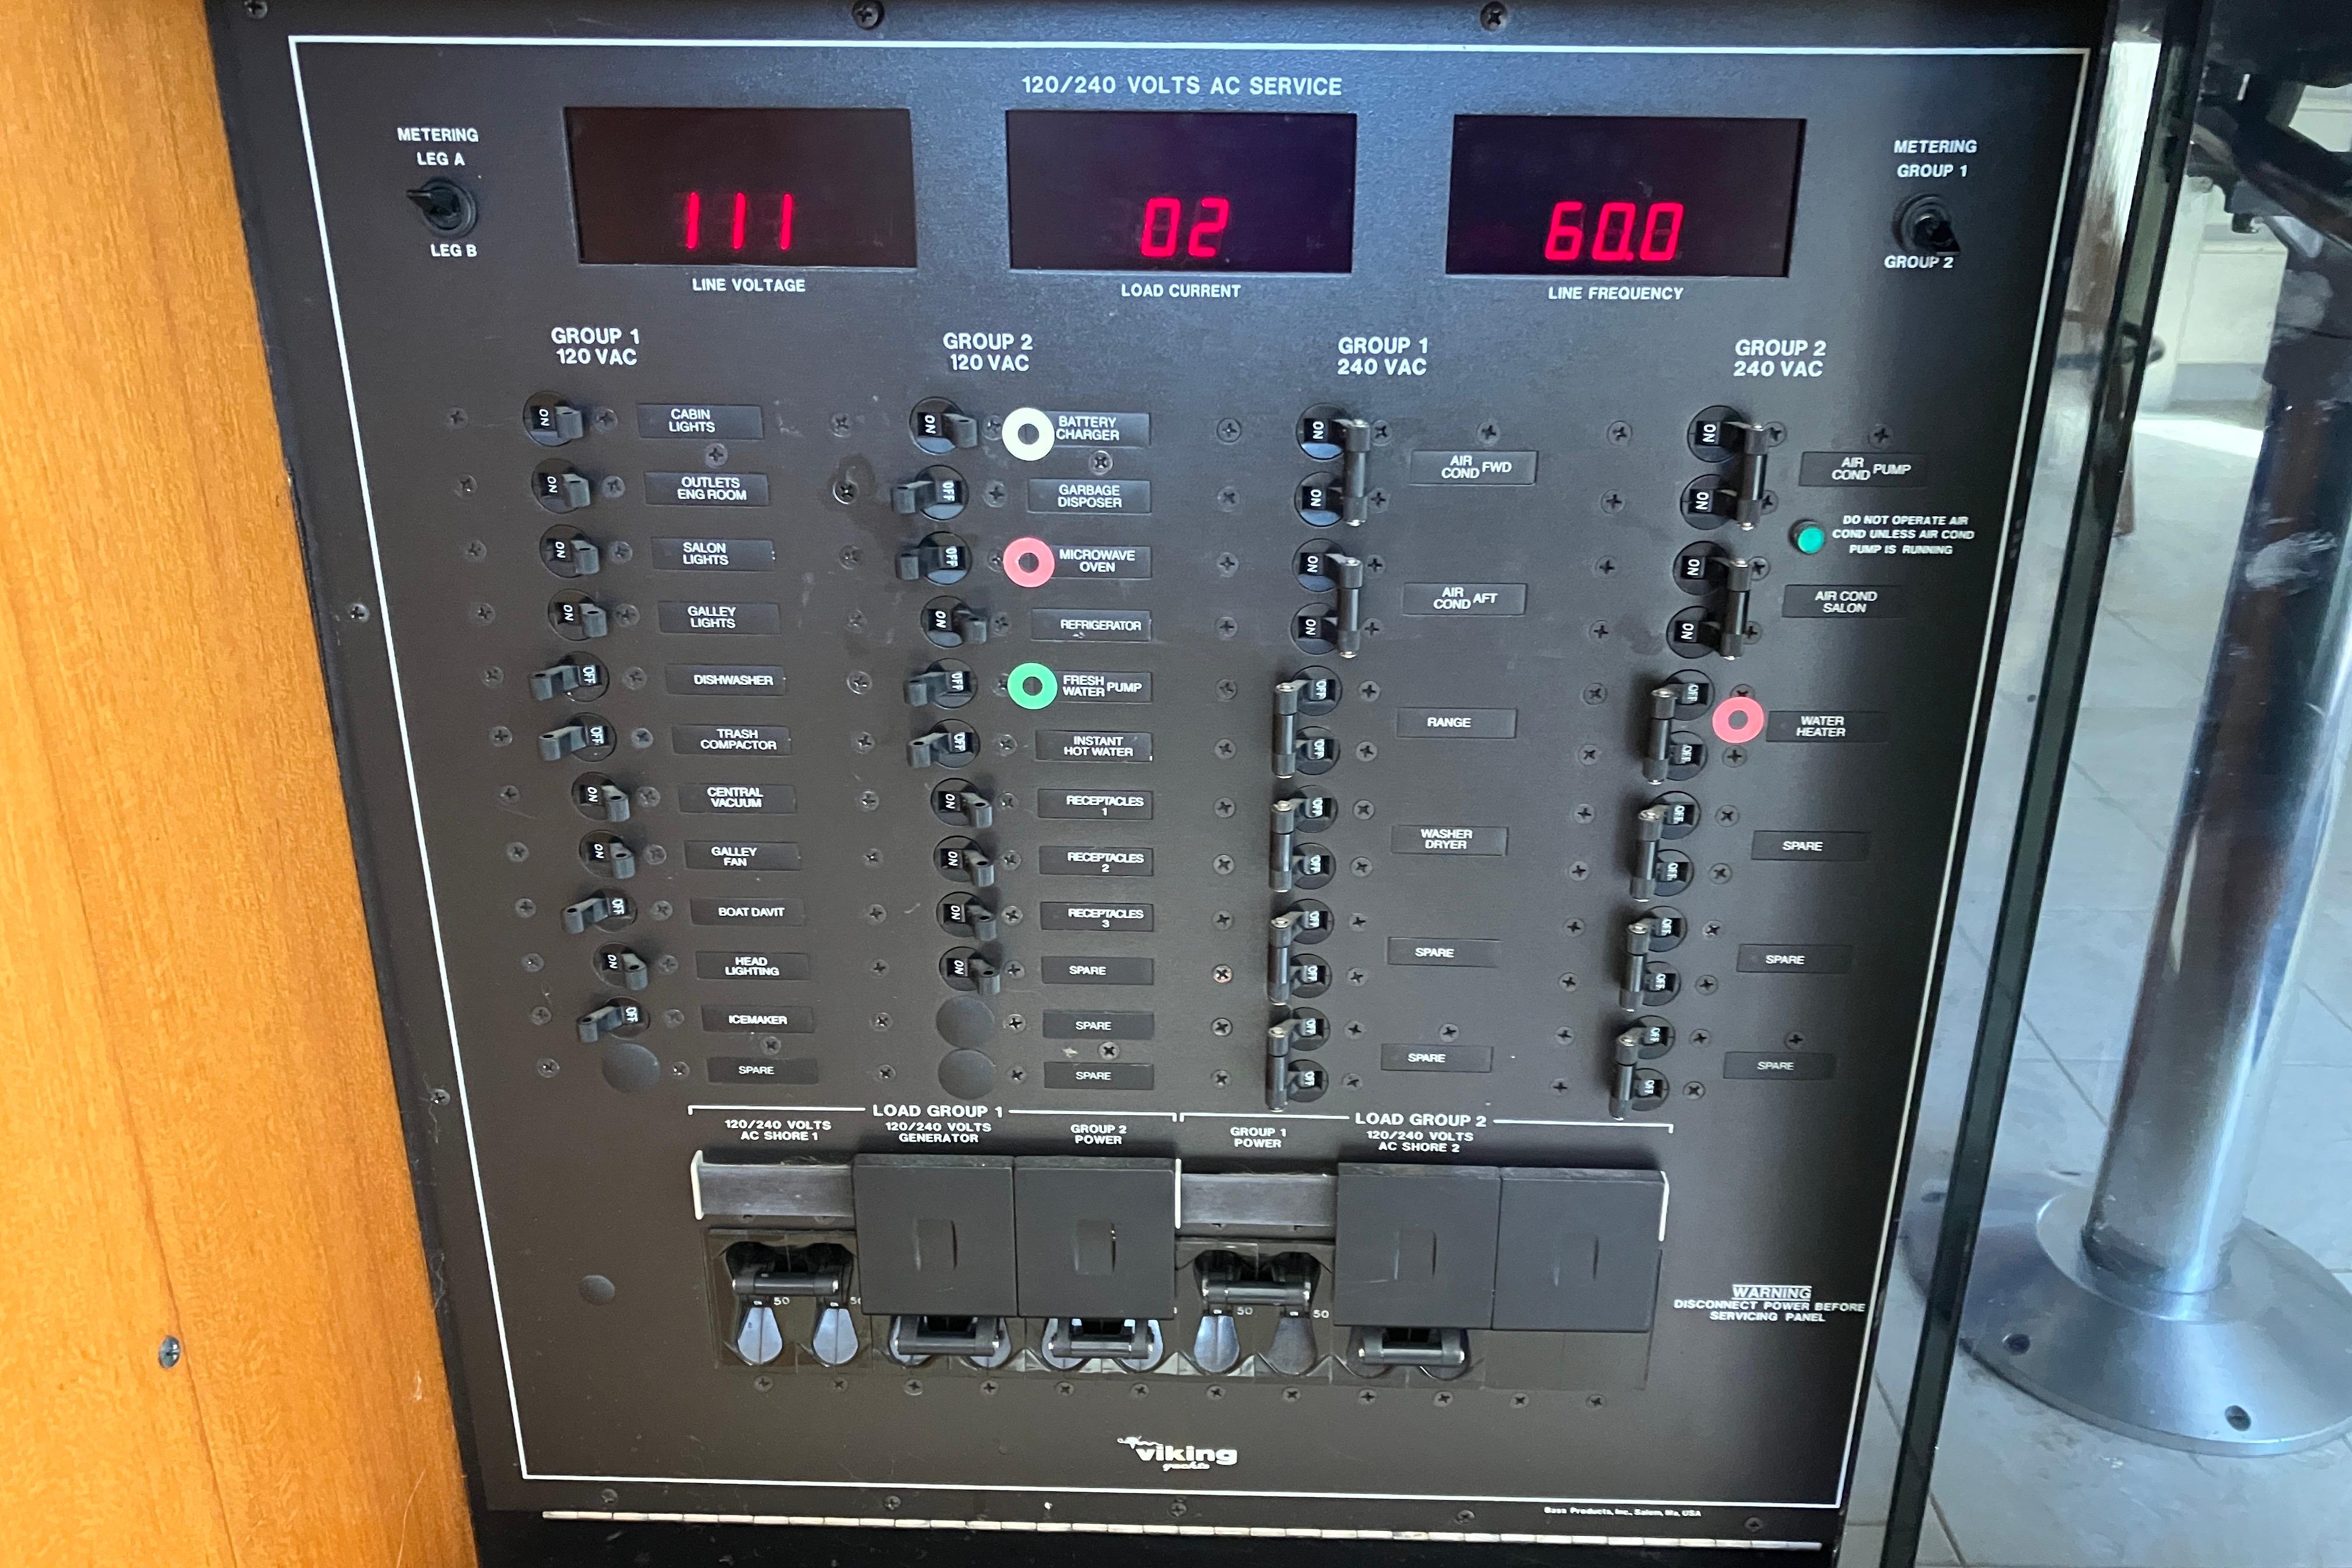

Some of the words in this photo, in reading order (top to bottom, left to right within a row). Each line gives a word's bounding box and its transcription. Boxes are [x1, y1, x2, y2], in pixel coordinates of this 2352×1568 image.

[1022, 76, 1115, 93] 120/240
[1128, 76, 1200, 94] VOLTS
[1210, 76, 1240, 94] AC
[1250, 76, 1342, 95] SERVICE
[397, 128, 478, 142] METERING
[1894, 139, 1977, 153] METERING
[417, 152, 449, 165] LEG
[454, 152, 465, 166] A
[1897, 164, 1953, 177] GROUP
[1960, 165, 1967, 177] 1
[686, 192, 793, 250] 111
[1141, 197, 1229, 257] 02
[430, 244, 462, 257] LEG
[466, 244, 477, 257] B
[1884, 255, 1940, 268] GROUP
[1943, 257, 1954, 268] 2
[692, 278, 726, 291] LINE
[732, 278, 806, 292] VOLTAGE
[1122, 284, 1163, 296] LOAD
[1169, 284, 1241, 298] CURRENT
[1549, 287, 1583, 299] LINE
[1589, 287, 1684, 300] FREQUENCY
[551, 327, 622, 344] GROUP
[630, 328, 639, 344] 1
[943, 332, 1014, 349] GROUP
[1021, 334, 1032, 350] 2
[1339, 337, 1410, 354] GROUP
[1419, 338, 1427, 354] 1
[1735, 340, 1808, 356] GROUP
[1814, 341, 1826, 356] 2
[556, 348, 590, 364] 120
[595, 348, 637, 365] VAC
[951, 354, 983, 370] 120
[988, 354, 1029, 371] VAC
[1338, 358, 1377, 374] 240
[1384, 358, 1426, 375] VAC
[1734, 361, 1774, 376] 240
[1781, 360, 1823, 377] VAC
[671, 408, 710, 419] CABIN
[669, 421, 715, 432] LIGHTS
[1059, 416, 1116, 428] BATTERY
[1058, 429, 1119, 440] CHARGER
[1450, 455, 1472, 466] AIR
[1842, 457, 1864, 467] AIR
[1441, 468, 1479, 478] COND
[1482, 462, 1511, 473] FWD
[1832, 470, 1871, 480] COND
[1873, 464, 1911, 474] PUMP
[681, 477, 740, 488] OUTLETS
[677, 489, 705, 499] ENG
[707, 489, 747, 500] ROOM
[1059, 484, 1120, 496] GARBAGE
[1058, 497, 1122, 508] DISPOSER
[1843, 515, 1861, 524] DO
[1864, 516, 1889, 524] NOT
[1892, 516, 1946, 525] OPERATE
[1948, 516, 1969, 524] AIR
[1832, 529, 1866, 538] COND
[1870, 530, 1916, 538] UNLESS
[1919, 530, 1938, 538] AIR
[1941, 530, 1975, 539] COND
[683, 542, 726, 553] SALON
[1849, 545, 1882, 554] PUMP
[1884, 545, 1896, 554] IS
[1902, 545, 1952, 554] RUNNING
[683, 554, 729, 565] LIGHTS
[1060, 549, 1135, 561] MICROWAVE
[1080, 562, 1115, 572] OVEN
[1442, 587, 1464, 597] AIR
[1815, 591, 1837, 600] AIR
[1840, 591, 1878, 601] COND
[1433, 599, 1471, 609] COND
[1473, 593, 1498, 603] AFT
[688, 606, 736, 617] GALLEY
[1823, 603, 1867, 612] SALON
[691, 618, 736, 628] LIGHTS
[1060, 620, 1141, 631] REFRIGERATOR
[694, 675, 774, 685] DISHWASHER
[1063, 675, 1104, 685] FRESH
[1063, 687, 1105, 696] WATER
[1107, 682, 1142, 692] PUMP
[1427, 718, 1471, 727] RANGE
[1801, 716, 1844, 726] WATER
[716, 729, 758, 738] TRASH
[1797, 727, 1846, 737] HEATER
[701, 740, 776, 750] COMPACTOR
[1074, 736, 1124, 746] INSTANT
[1064, 747, 1089, 755] HOT
[1091, 747, 1133, 757] WATER
[707, 787, 764, 797] CENTRAL
[710, 798, 761, 807] VACUUM
[1066, 796, 1144, 806] RECEPTACLES
[1421, 829, 1472, 839] WASHER
[1425, 840, 1466, 849] DRYER
[1783, 841, 1823, 851] SPARE
[712, 846, 757, 856] GALLEY
[724, 858, 747, 866] FAN
[1068, 852, 1144, 863] RECEPTACLES
[1102, 864, 1109, 872] 2
[719, 908, 750, 916] BOAT
[751, 908, 785, 916] DAVIT
[1068, 908, 1144, 919] RECEPTACLES
[736, 957, 768, 966] HEAD
[1766, 955, 1805, 964] SPARE
[725, 967, 779, 975] LIGHTING
[729, 1015, 787, 1024] ICEMAKER
[1408, 1054, 1446, 1062] SPARE
[1076, 1072, 1111, 1080] SPARE
[873, 1104, 921, 1116] LOAD
[927, 1105, 988, 1117] GROUP
[995, 1107, 1002, 1118] 1
[725, 1119, 782, 1129] 120/240
[787, 1121, 831, 1130] VOLTS
[1356, 1112, 1404, 1125] LOAD
[1409, 1114, 1471, 1126] GROUP
[1475, 1116, 1486, 1127] 2
[886, 1122, 942, 1131] 120/240
[947, 1122, 991, 1132] VOLTS
[1070, 1124, 1115, 1133] GROUP
[1119, 1125, 1126, 1133] 2
[1230, 1127, 1275, 1136] GROUP
[741, 1131, 759, 1140] AC
[764, 1131, 808, 1140] SHORE
[812, 1132, 818, 1140] 1
[899, 1133, 978, 1143] GENERATOR
[1075, 1135, 1122, 1144] POWER
[1366, 1130, 1423, 1140] 120/240
[1429, 1132, 1474, 1141] VOLTS
[1234, 1138, 1281, 1148] POWER
[1378, 1142, 1397, 1150] AC
[1402, 1142, 1447, 1152] SHORE
[1451, 1144, 1460, 1152] 2
[1732, 1286, 1811, 1299] WARNING
[774, 1297, 789, 1306] 50
[1674, 1299, 1758, 1310] DISCONNECT
[1763, 1301, 1809, 1311] POWER
[1814, 1303, 1866, 1312] BEFORE
[1237, 1307, 1252, 1315] 50
[1313, 1310, 1329, 1318] 50
[1710, 1311, 1778, 1321] SERVICING
[1785, 1312, 1826, 1322] PANEL
[1136, 1446, 1238, 1466] viking
